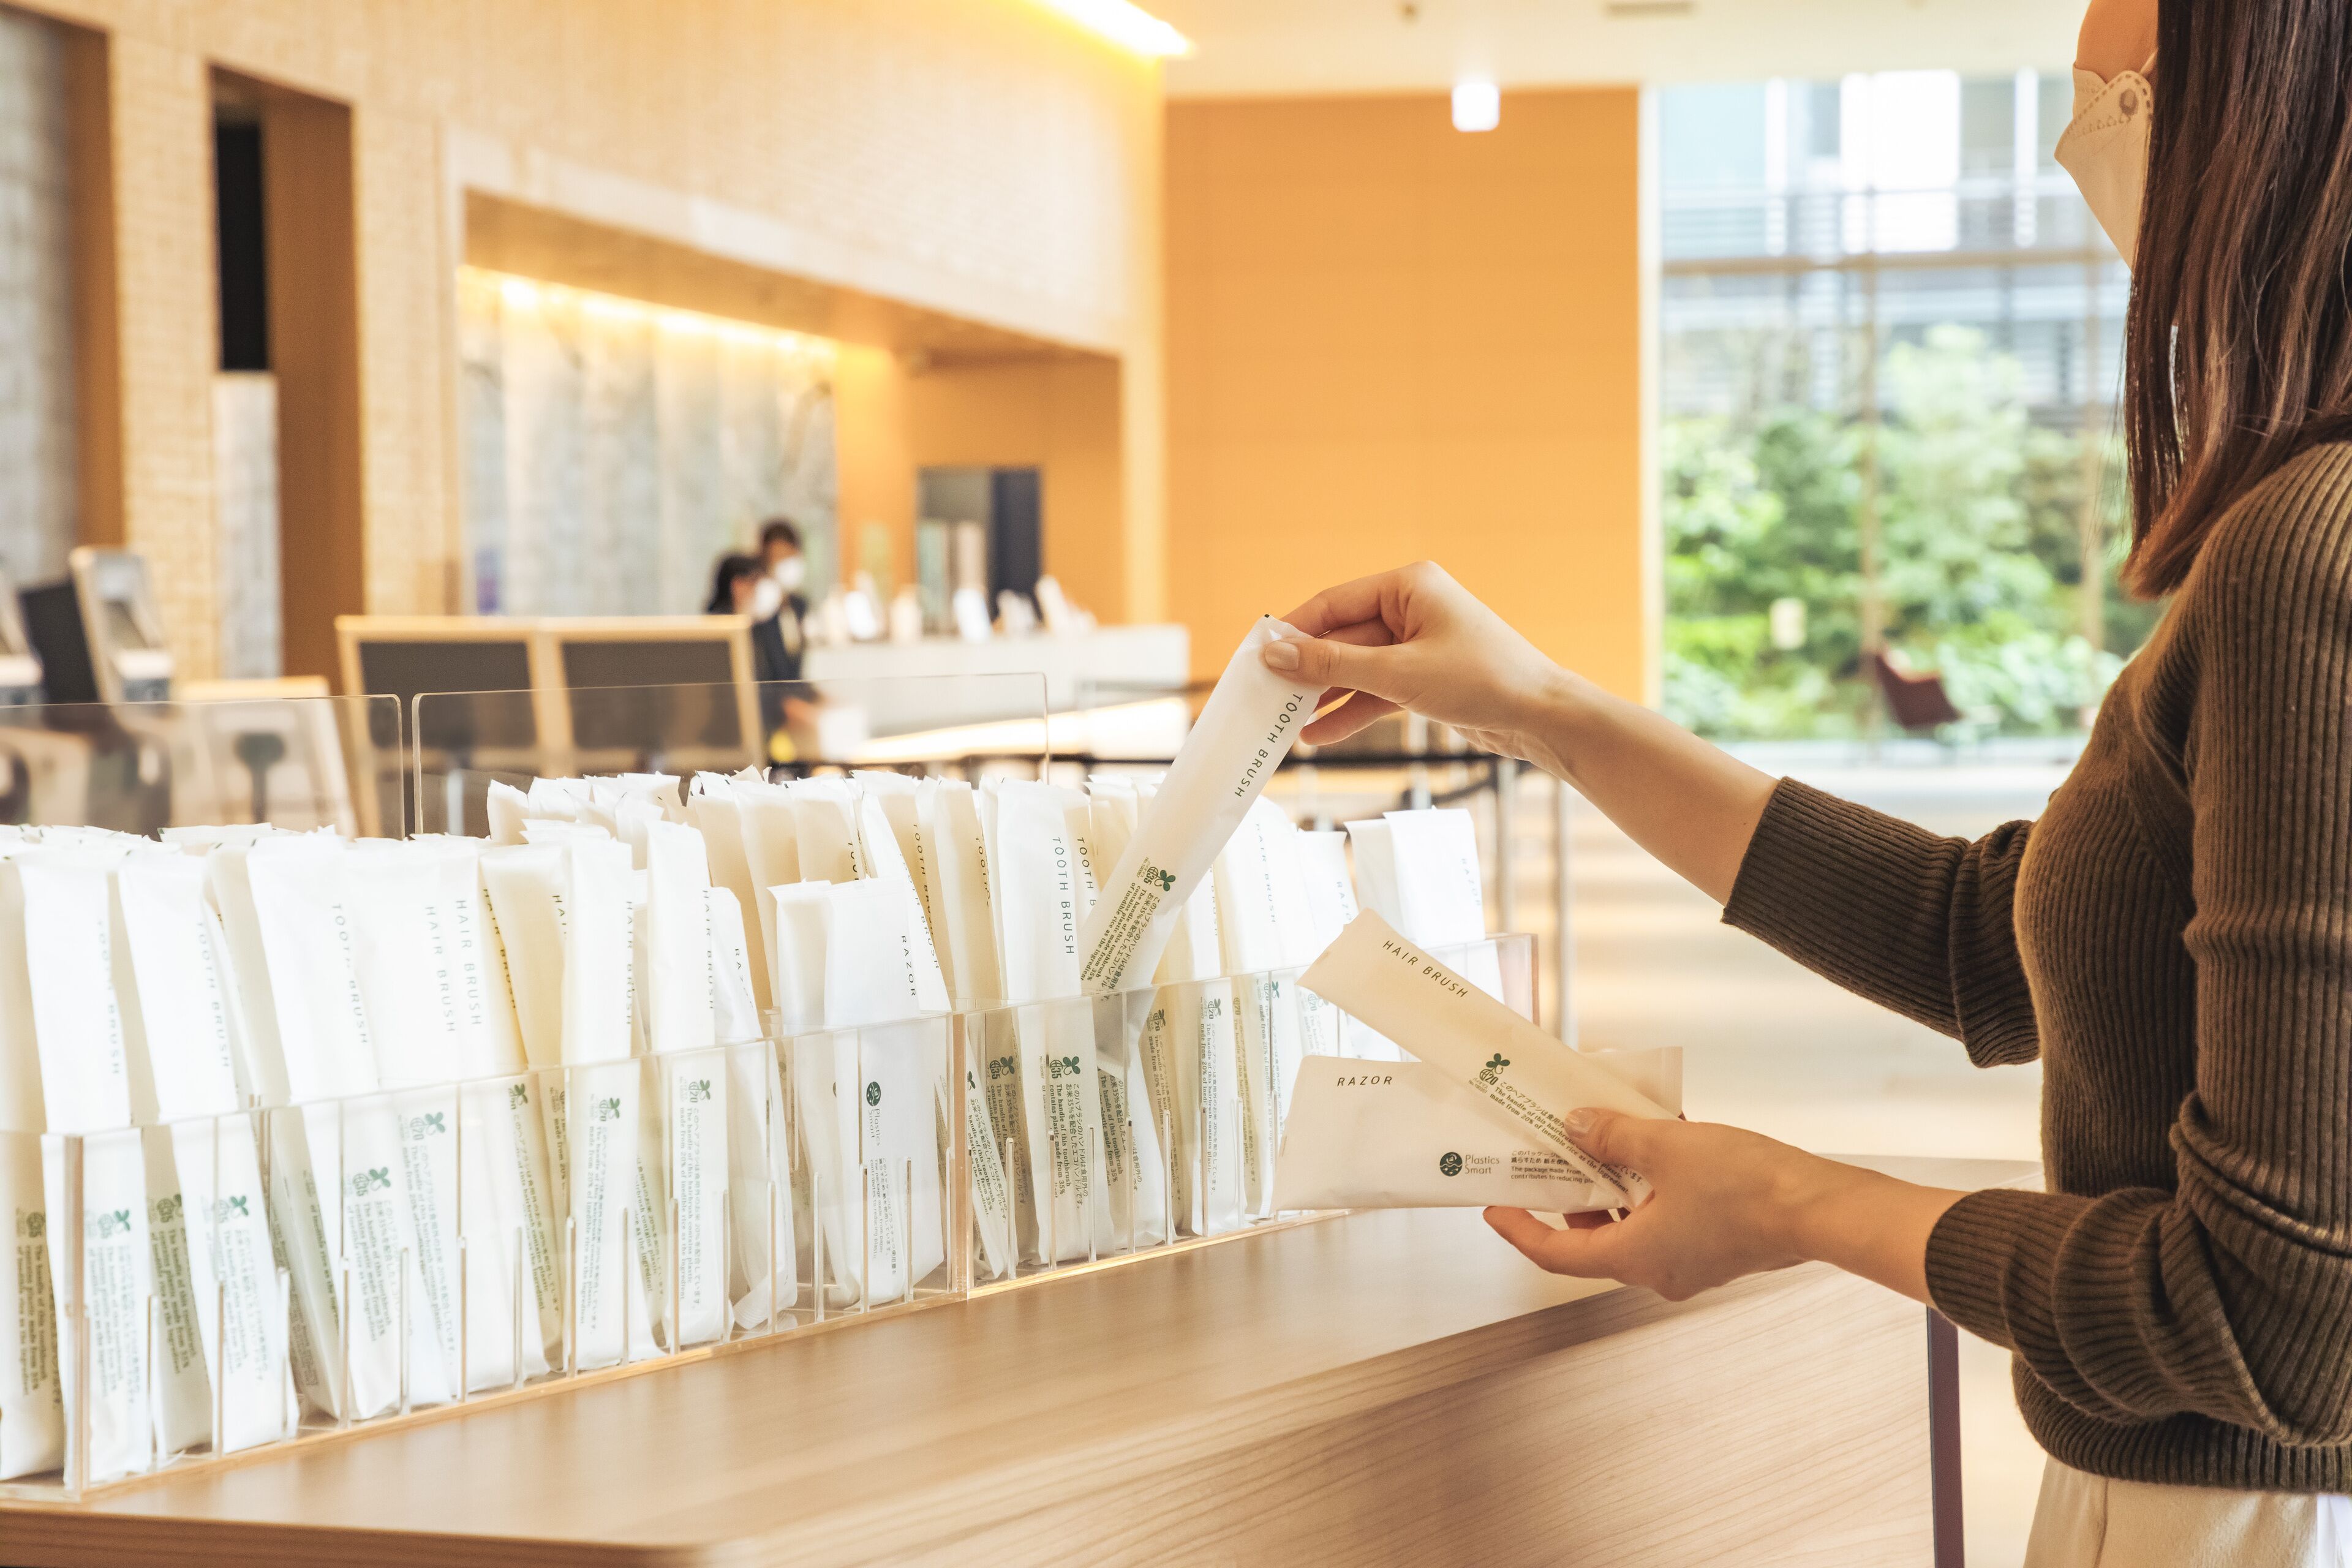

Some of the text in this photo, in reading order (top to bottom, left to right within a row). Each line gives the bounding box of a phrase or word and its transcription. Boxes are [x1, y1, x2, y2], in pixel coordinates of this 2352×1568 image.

[1234, 691, 1303, 797] TOOTH BRUSH
[1077, 837, 1093, 889] TOOTH
[1142, 872, 1155, 886] 35
[1052, 836, 1074, 954] TOOTH BRUSH
[1125, 900, 1140, 922] handle
[1136, 888, 1147, 900] The
[1080, 881, 1137, 981] of inedible rice as the ingredient
[1086, 884, 1141, 982] contains plastic made from 35%
[1113, 930, 1124, 943] this
[1120, 922, 1128, 931] of
[424, 905, 456, 1031] HAIR BRUSH
[455, 899, 481, 1025] HAIR BRUSH
[901, 935, 916, 996] RAZOR
[1095, 944, 1117, 978] toothbrush
[1382, 939, 1468, 998] HAIR BRUSH
[211, 1001, 229, 1067] BRUSH
[990, 1068, 1000, 1079] 35
[1050, 1067, 1061, 1079] 35
[1336, 1076, 1392, 1087] RAZOR
[1485, 1072, 1499, 1087] 20
[990, 1085, 998, 1114] contains
[1049, 1084, 1057, 1114] contains
[873, 1108, 882, 1146] Plastics
[1102, 1090, 1112, 1112] handle
[1111, 1137, 1123, 1174] toothbrush
[1489, 1091, 1507, 1106] made
[1506, 1102, 1521, 1116] from
[1520, 1112, 1535, 1126] 20%
[1533, 1121, 1542, 1131] of
[1540, 1127, 1566, 1147] inedible
[1564, 1144, 1579, 1157] rice
[1577, 1153, 1587, 1163] as
[1585, 1158, 1597, 1170] the
[1494, 1086, 1507, 1098] The
[1505, 1094, 1528, 1112] handle
[1526, 1109, 1536, 1118] of
[1534, 1114, 1547, 1126] this
[1599, 1161, 1623, 1180] plastic
[410, 1145, 418, 1161] The
[967, 1133, 978, 1155] plastic
[974, 1157, 983, 1175] made
[979, 1178, 988, 1194] from
[968, 1115, 978, 1138] handle
[981, 1164, 995, 1202] toothbrush
[1062, 1148, 1071, 1186] toothbrush
[1464, 1154, 1499, 1164] Plastics
[1464, 1164, 1491, 1174] Smart
[405, 1170, 413, 1191] from
